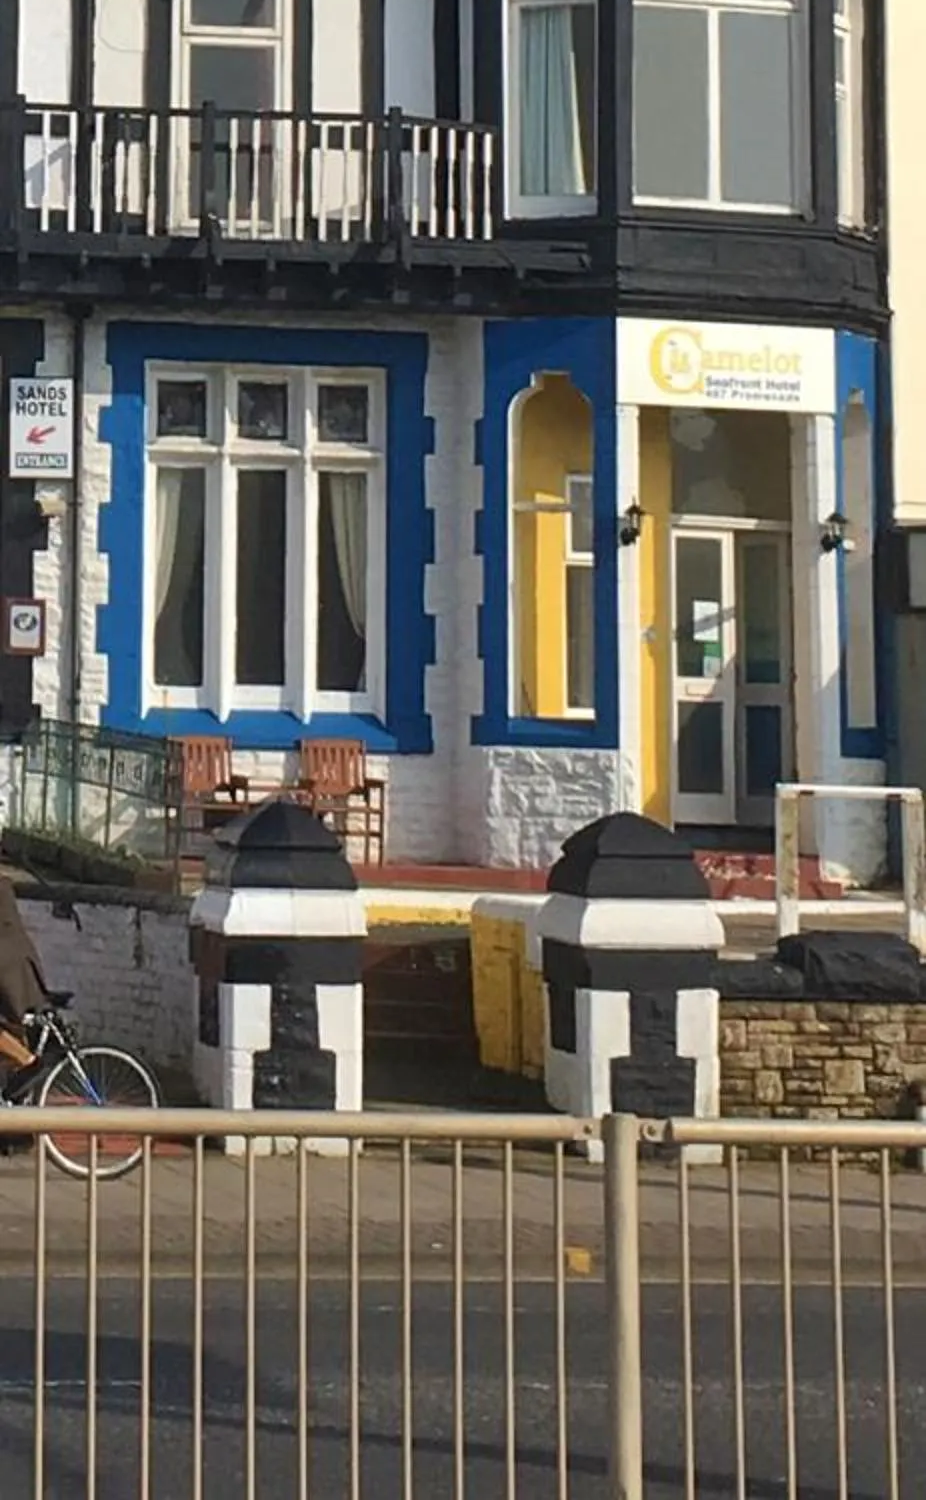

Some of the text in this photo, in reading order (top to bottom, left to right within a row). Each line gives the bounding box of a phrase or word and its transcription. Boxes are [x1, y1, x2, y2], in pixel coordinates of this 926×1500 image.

[649, 327, 802, 395] Camelot
[704, 375, 800, 392] Seafront Hotel
[17, 385, 68, 401] SANDS
[15, 401, 68, 417] HOTEL
